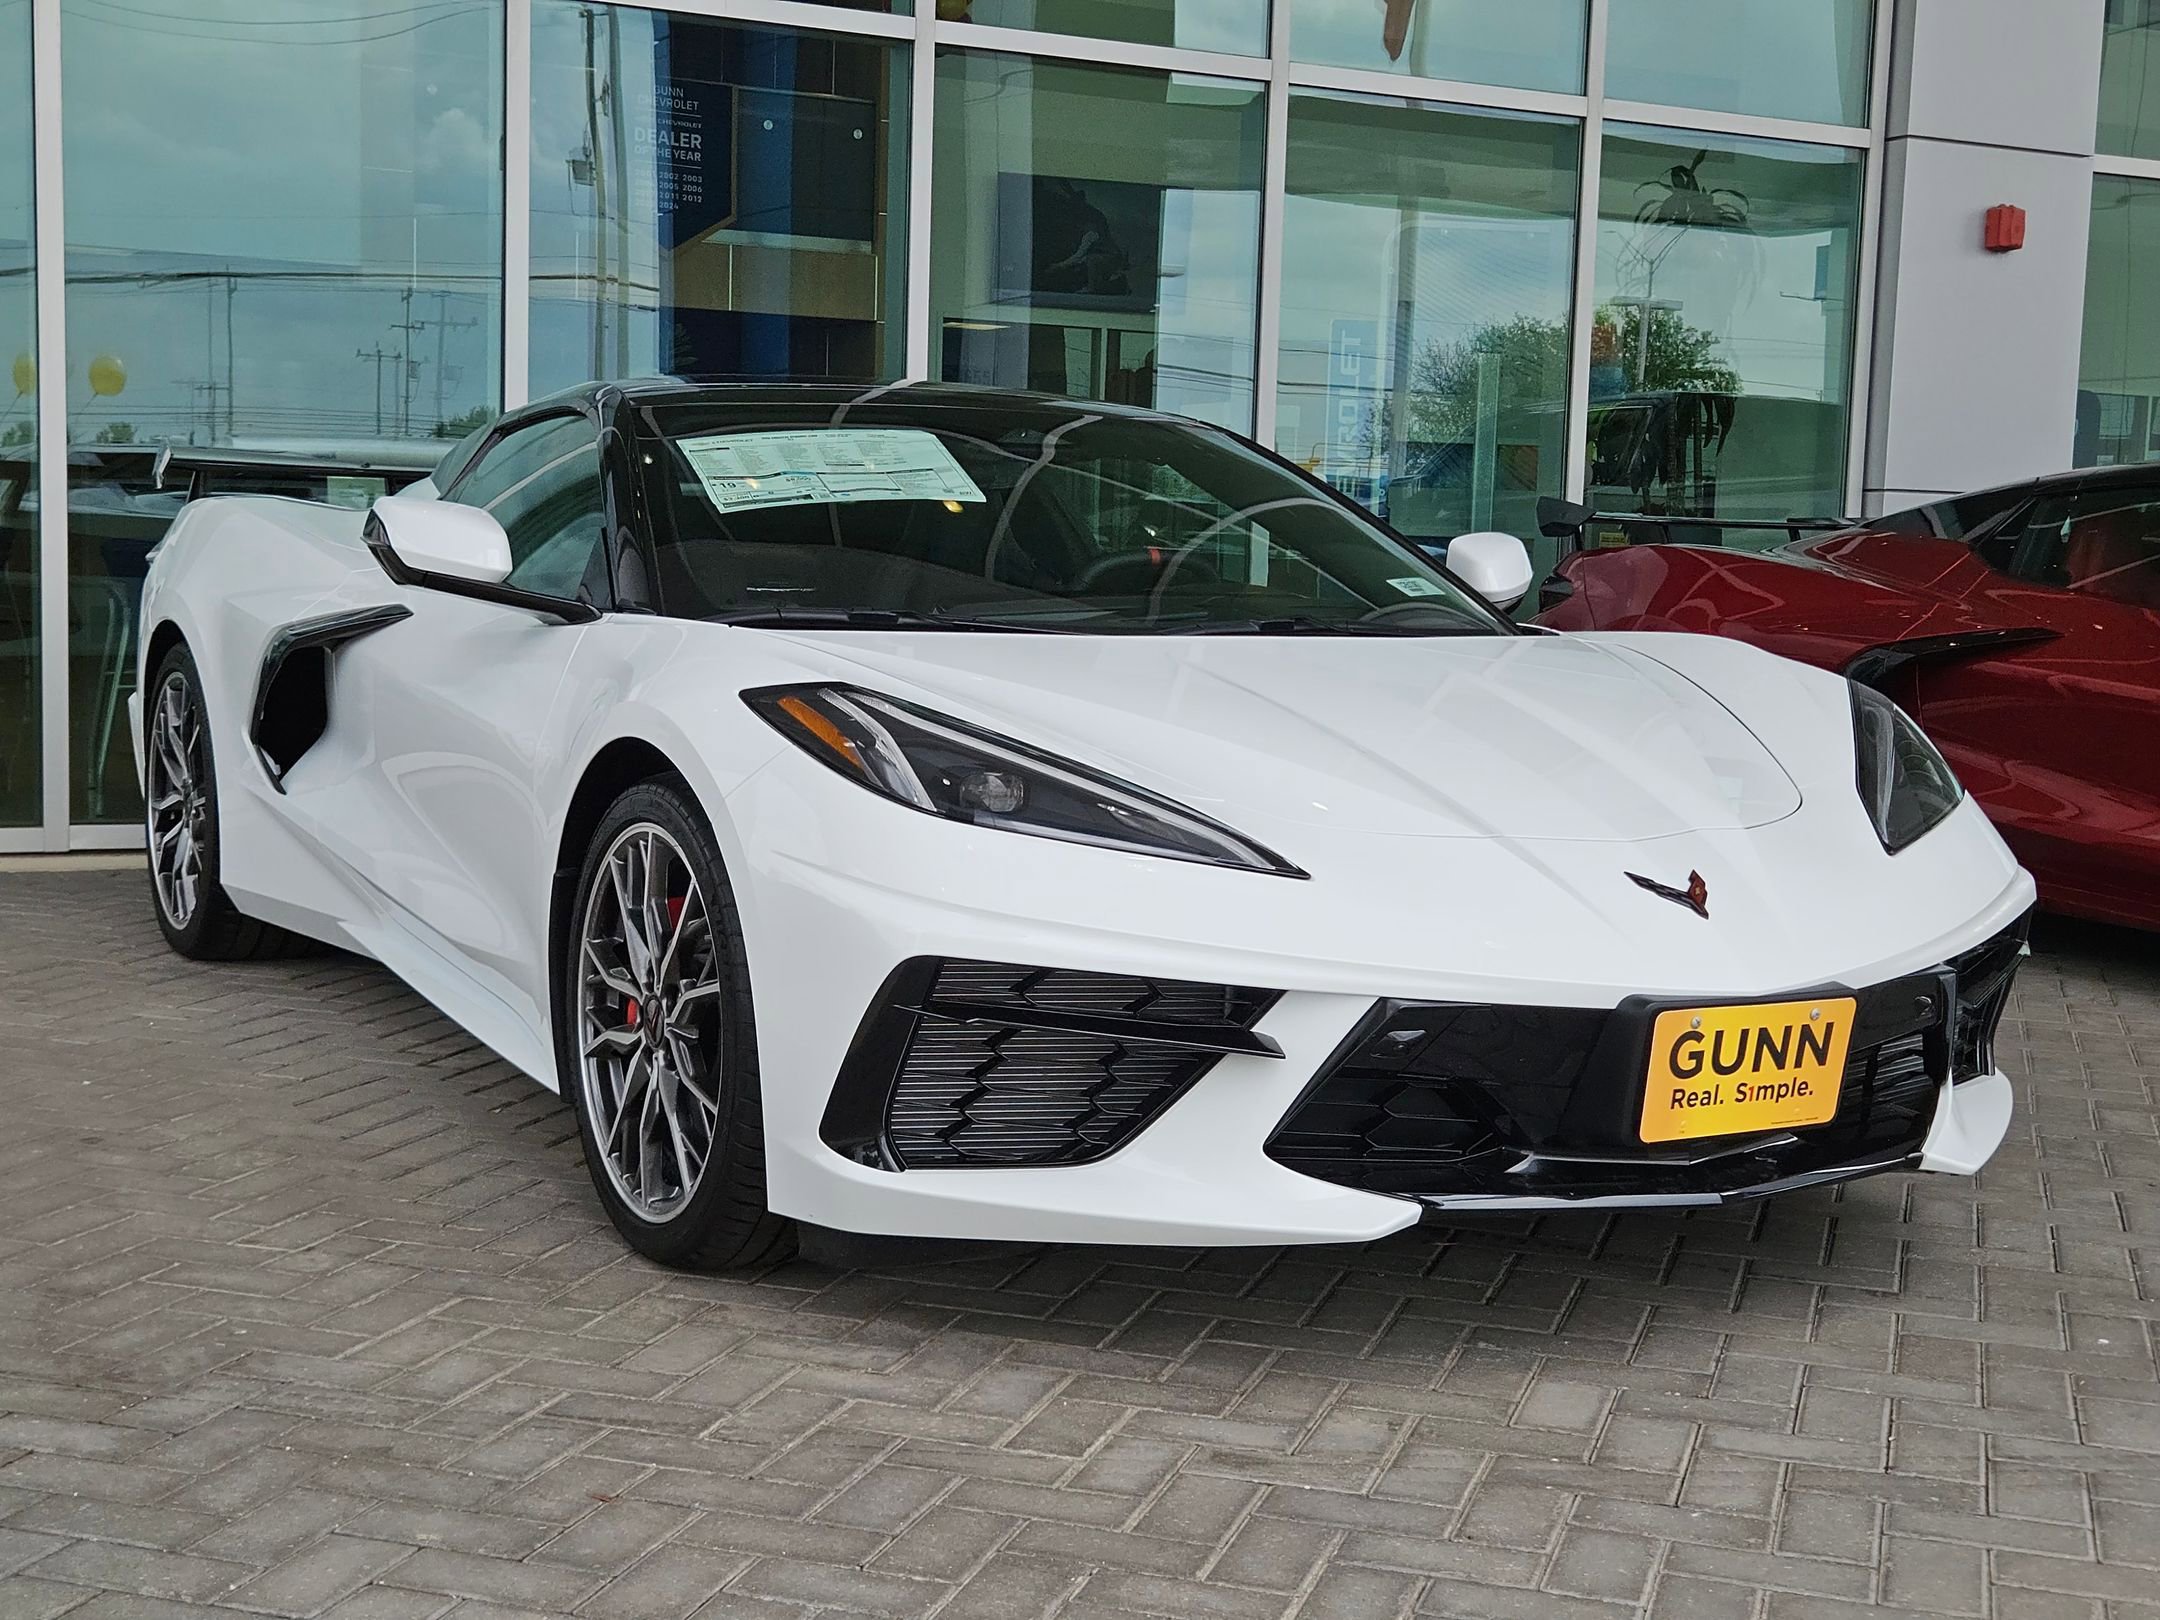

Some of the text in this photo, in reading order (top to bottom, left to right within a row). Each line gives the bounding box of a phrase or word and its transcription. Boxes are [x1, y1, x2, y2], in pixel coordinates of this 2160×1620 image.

[634, 128, 702, 148] DEALER
[653, 147, 671, 158] HE
[673, 149, 701, 161] YEAR
[1669, 1022, 1835, 1079] GUNN
[1670, 1084, 1724, 1110] Real.
